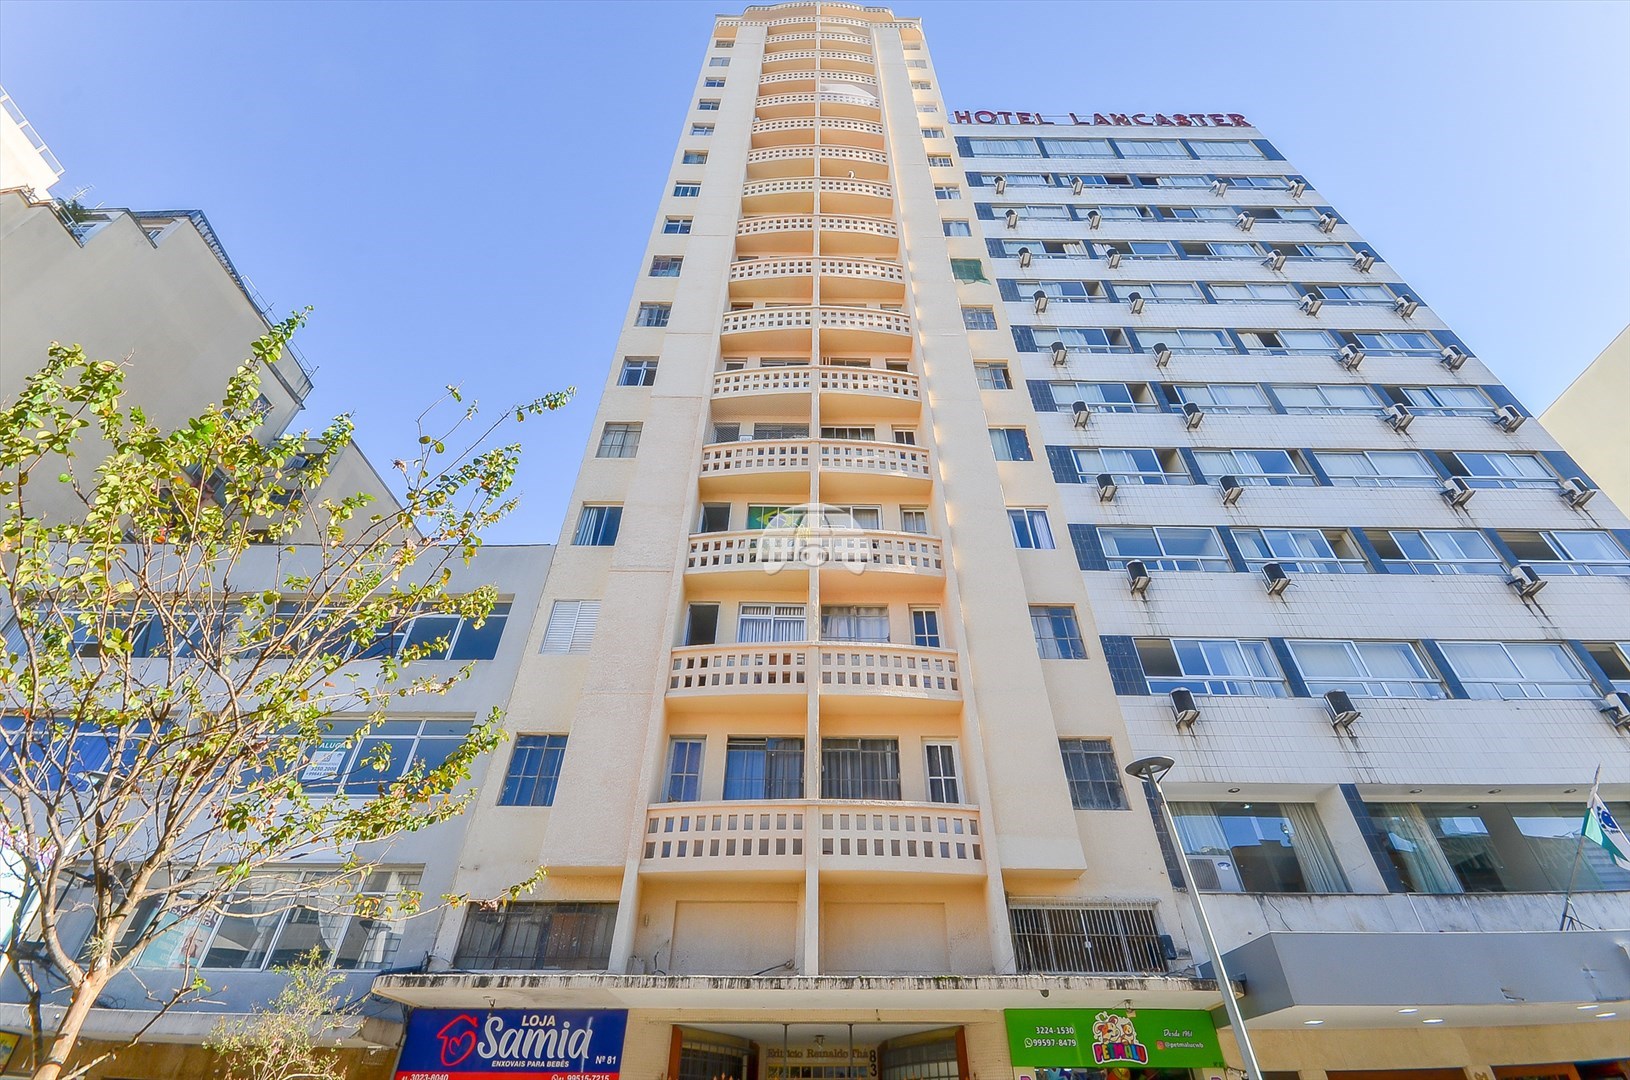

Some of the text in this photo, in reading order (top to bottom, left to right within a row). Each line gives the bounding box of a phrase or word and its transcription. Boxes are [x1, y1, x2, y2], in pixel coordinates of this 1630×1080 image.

[954, 110, 1252, 127] HOTEL LANCASTER
[521, 1015, 556, 1027] LOJA
[1036, 1026, 1075, 1035] 3224-1530
[477, 1016, 593, 1059] Samia
[1033, 1039, 1077, 1047] 99597-8479
[1093, 1041, 1148, 1064] PETMALU
[491, 1060, 526, 1068] ENXOVAIS
[606, 1055, 617, 1065] 81
